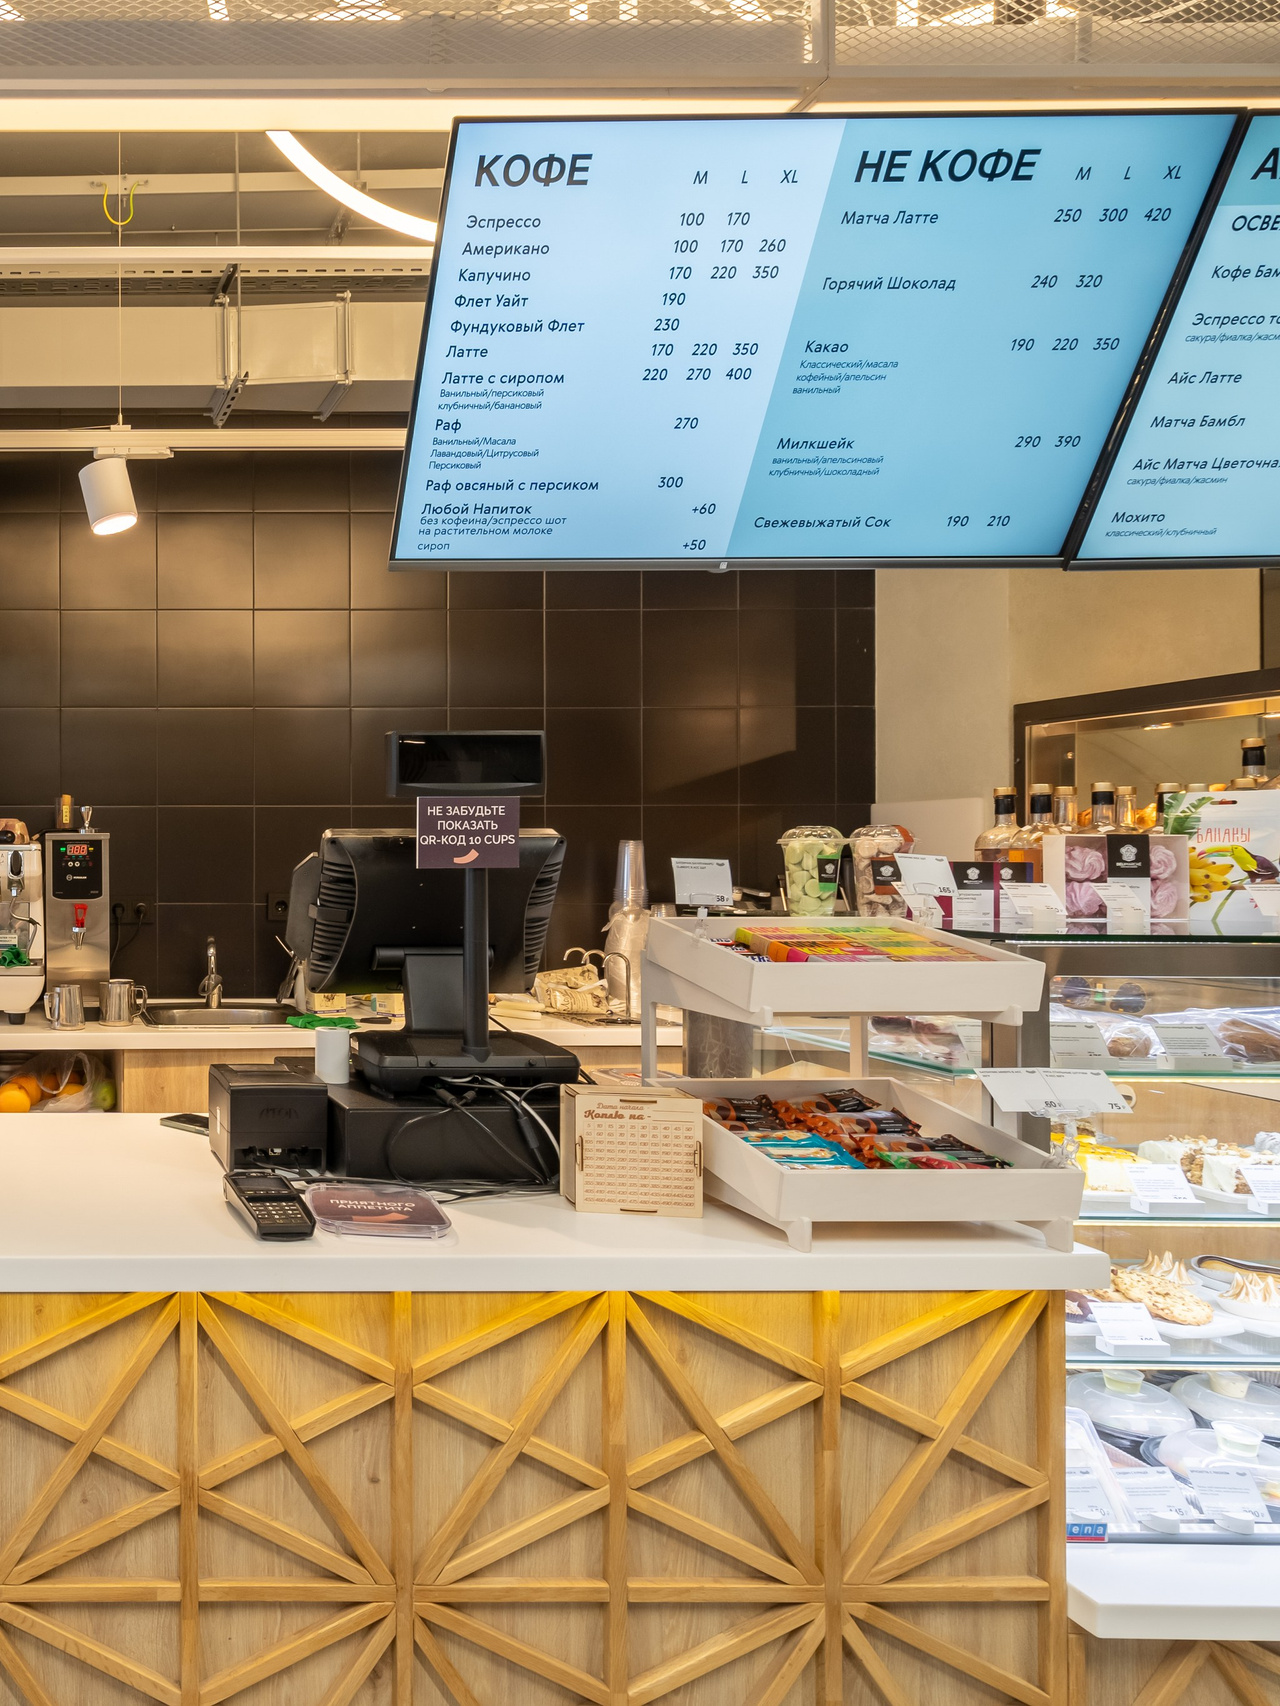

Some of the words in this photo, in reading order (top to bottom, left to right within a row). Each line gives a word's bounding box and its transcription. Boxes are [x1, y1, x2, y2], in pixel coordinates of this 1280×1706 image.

[475, 153, 593, 187] КОФЕ
[854, 150, 912, 183] НЕ
[918, 148, 1042, 182] КОФЕ
[1124, 166, 1131, 180] L
[1163, 165, 1181, 179] XL
[741, 170, 748, 184] L
[780, 170, 798, 183] XL
[466, 215, 541, 232] Эспрессо
[680, 212, 705, 226] 100
[728, 212, 750, 226] 170
[841, 211, 892, 224] Матча
[893, 210, 938, 224] Латте
[1054, 209, 1082, 222] 250
[1099, 208, 1128, 222] 300
[1144, 208, 1171, 221] 420
[1232, 215, 1280, 231] ОСВЕ
[462, 242, 549, 259] Американо
[674, 240, 698, 253] 100
[721, 239, 743, 253] 170
[759, 239, 786, 252] 260
[458, 268, 531, 285] Капучино
[670, 266, 692, 280] 170
[710, 266, 737, 279] 220
[752, 265, 779, 279] 350
[1211, 265, 1251, 282] Кофе
[823, 277, 883, 293] Горячий
[887, 276, 956, 291] Шоколад
[1031, 275, 1058, 288] 240
[1075, 275, 1103, 288] 320
[454, 294, 492, 310] Флет
[493, 294, 529, 309] Уайт
[663, 292, 686, 306] 190
[451, 320, 543, 337] Фундуковый
[548, 319, 585, 332] Флет
[654, 318, 680, 332] 230
[1192, 313, 1265, 329] Эспрессо
[446, 345, 488, 358] Латте
[652, 342, 674, 356] 170
[691, 343, 717, 356] 220
[732, 343, 758, 355] 350
[803, 340, 849, 353] Какао
[1011, 338, 1035, 351] 190
[1052, 338, 1079, 351] 220
[1093, 338, 1120, 350] 350
[800, 359, 898, 370] Классический/масала
[441, 372, 484, 386] Латте
[500, 374, 564, 387] сиропом
[642, 368, 668, 381] 220
[686, 368, 711, 380] 270
[725, 367, 752, 380] 400
[796, 372, 887, 383] кофейный/апельсин
[1167, 372, 1197, 384] Айс
[1199, 371, 1242, 383] Латте
[440, 387, 544, 400] Ванильный/персиковый
[792, 385, 841, 394] ванильный
[438, 400, 542, 412] клубничный/банановый
[435, 419, 461, 434] Раф
[674, 417, 698, 429] 270
[1150, 416, 1196, 428] Матча
[1199, 415, 1246, 427] Бамбл
[432, 436, 516, 448] Ванильный/Масала
[776, 437, 855, 451] Милкшейк
[1015, 436, 1041, 447] 290
[1054, 436, 1081, 447] 390
[430, 448, 539, 462] Лавандовый/Цитрусовый
[772, 455, 884, 466] ванильный/апельсиновый
[429, 460, 481, 471] Персиковый
[1132, 459, 1161, 470] Айс
[1163, 458, 1208, 470] Матча
[1211, 457, 1280, 471] Цветочна
[769, 467, 880, 477] клубничный/шоколадный
[426, 480, 452, 494] Раф
[455, 478, 514, 492] овсяный
[529, 482, 599, 493] персиком
[658, 476, 683, 488] 300
[421, 503, 470, 517] Любой
[473, 503, 532, 515] Напиток
[692, 503, 716, 514] +60
[420, 517, 438, 527] без
[442, 517, 542, 528] кофеина/эспрессо
[545, 518, 567, 526] шот
[754, 516, 861, 528] Свежевыжатый
[865, 516, 892, 527] Сок
[947, 516, 969, 527] 190
[987, 515, 1010, 526] 210
[1111, 512, 1165, 523] Мохито
[433, 528, 509, 538] растительном
[513, 526, 553, 535] молоке
[417, 543, 450, 552] сироп
[683, 539, 706, 550] +50
[428, 806, 442, 815] НЕ
[446, 806, 505, 817] ЗАБУДЬТЕ
[438, 821, 498, 830] ПОКАЗАТЬ
[420, 835, 466, 846] QR-КОД
[484, 835, 515, 844] CUPS
[1197, 828, 1251, 843] БАНАНЫ
